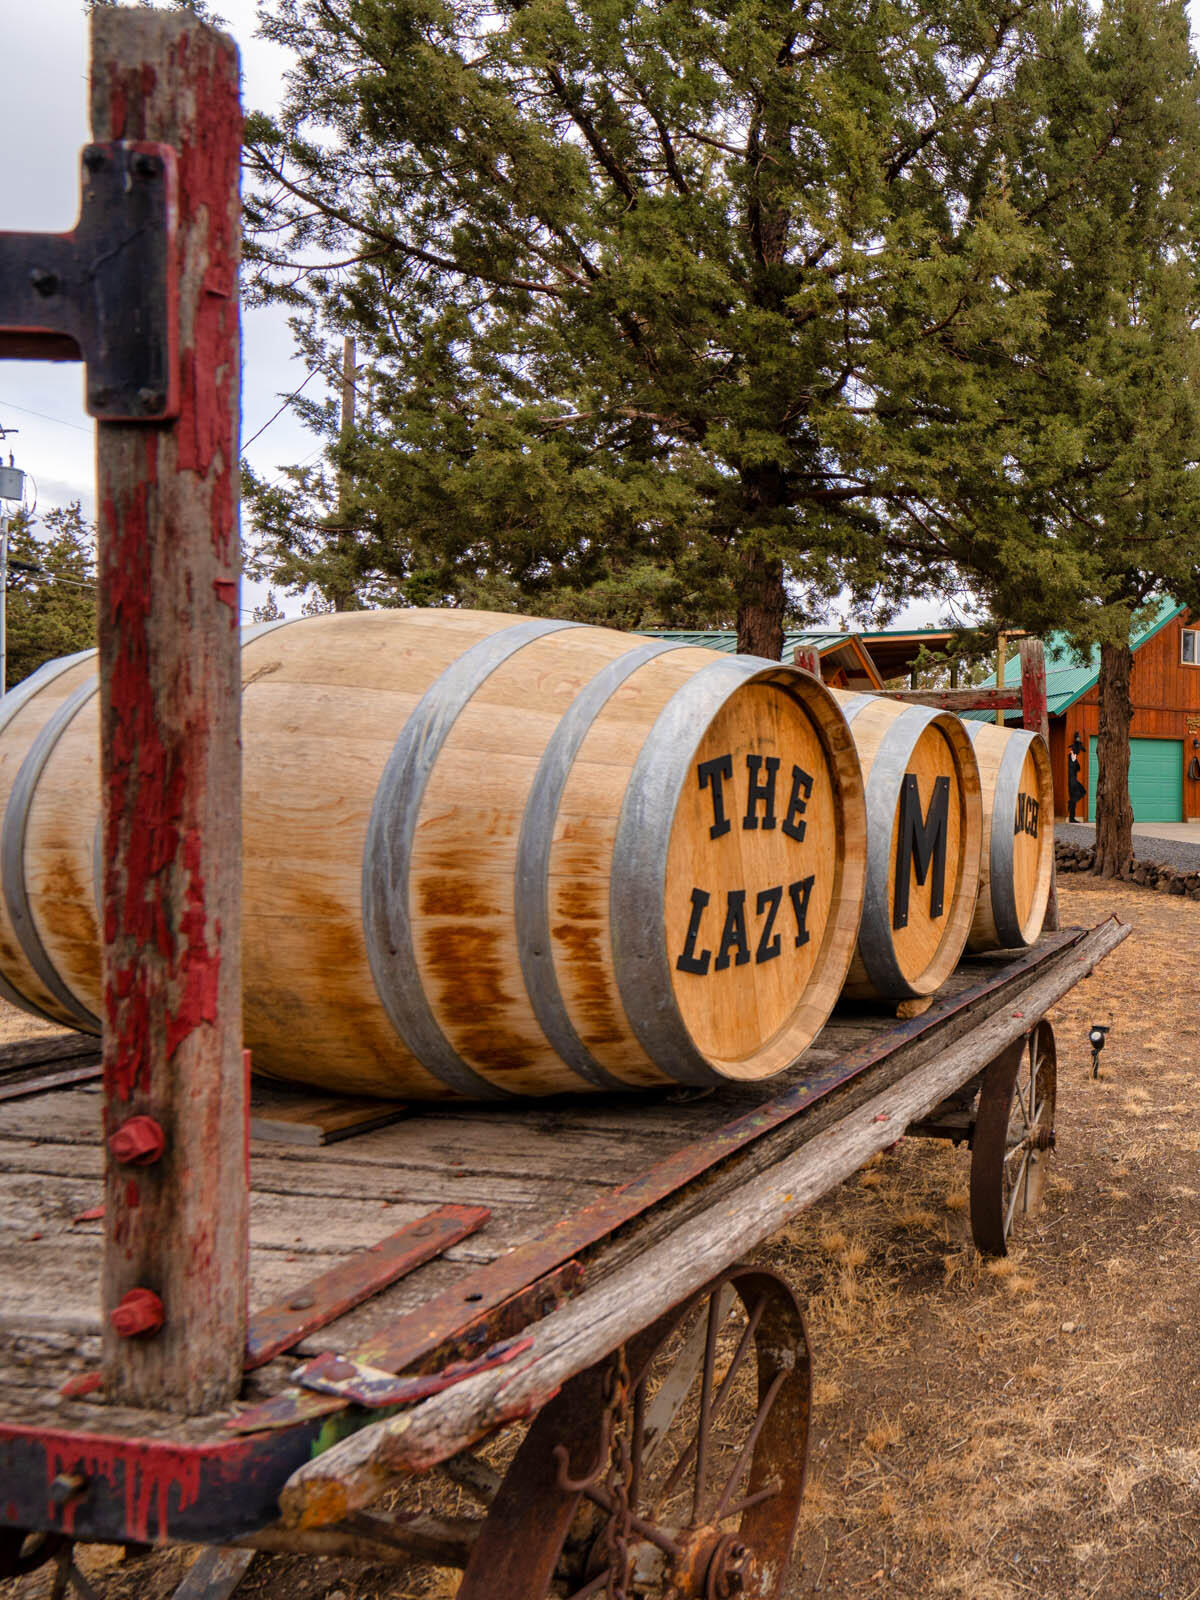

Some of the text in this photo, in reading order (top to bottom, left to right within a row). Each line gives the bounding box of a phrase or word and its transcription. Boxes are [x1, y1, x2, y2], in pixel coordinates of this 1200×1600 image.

[697, 754, 814, 842] THE
[1014, 792, 1039, 838] NCH
[893, 773, 950, 930] M
[676, 875, 815, 975] LAZY
